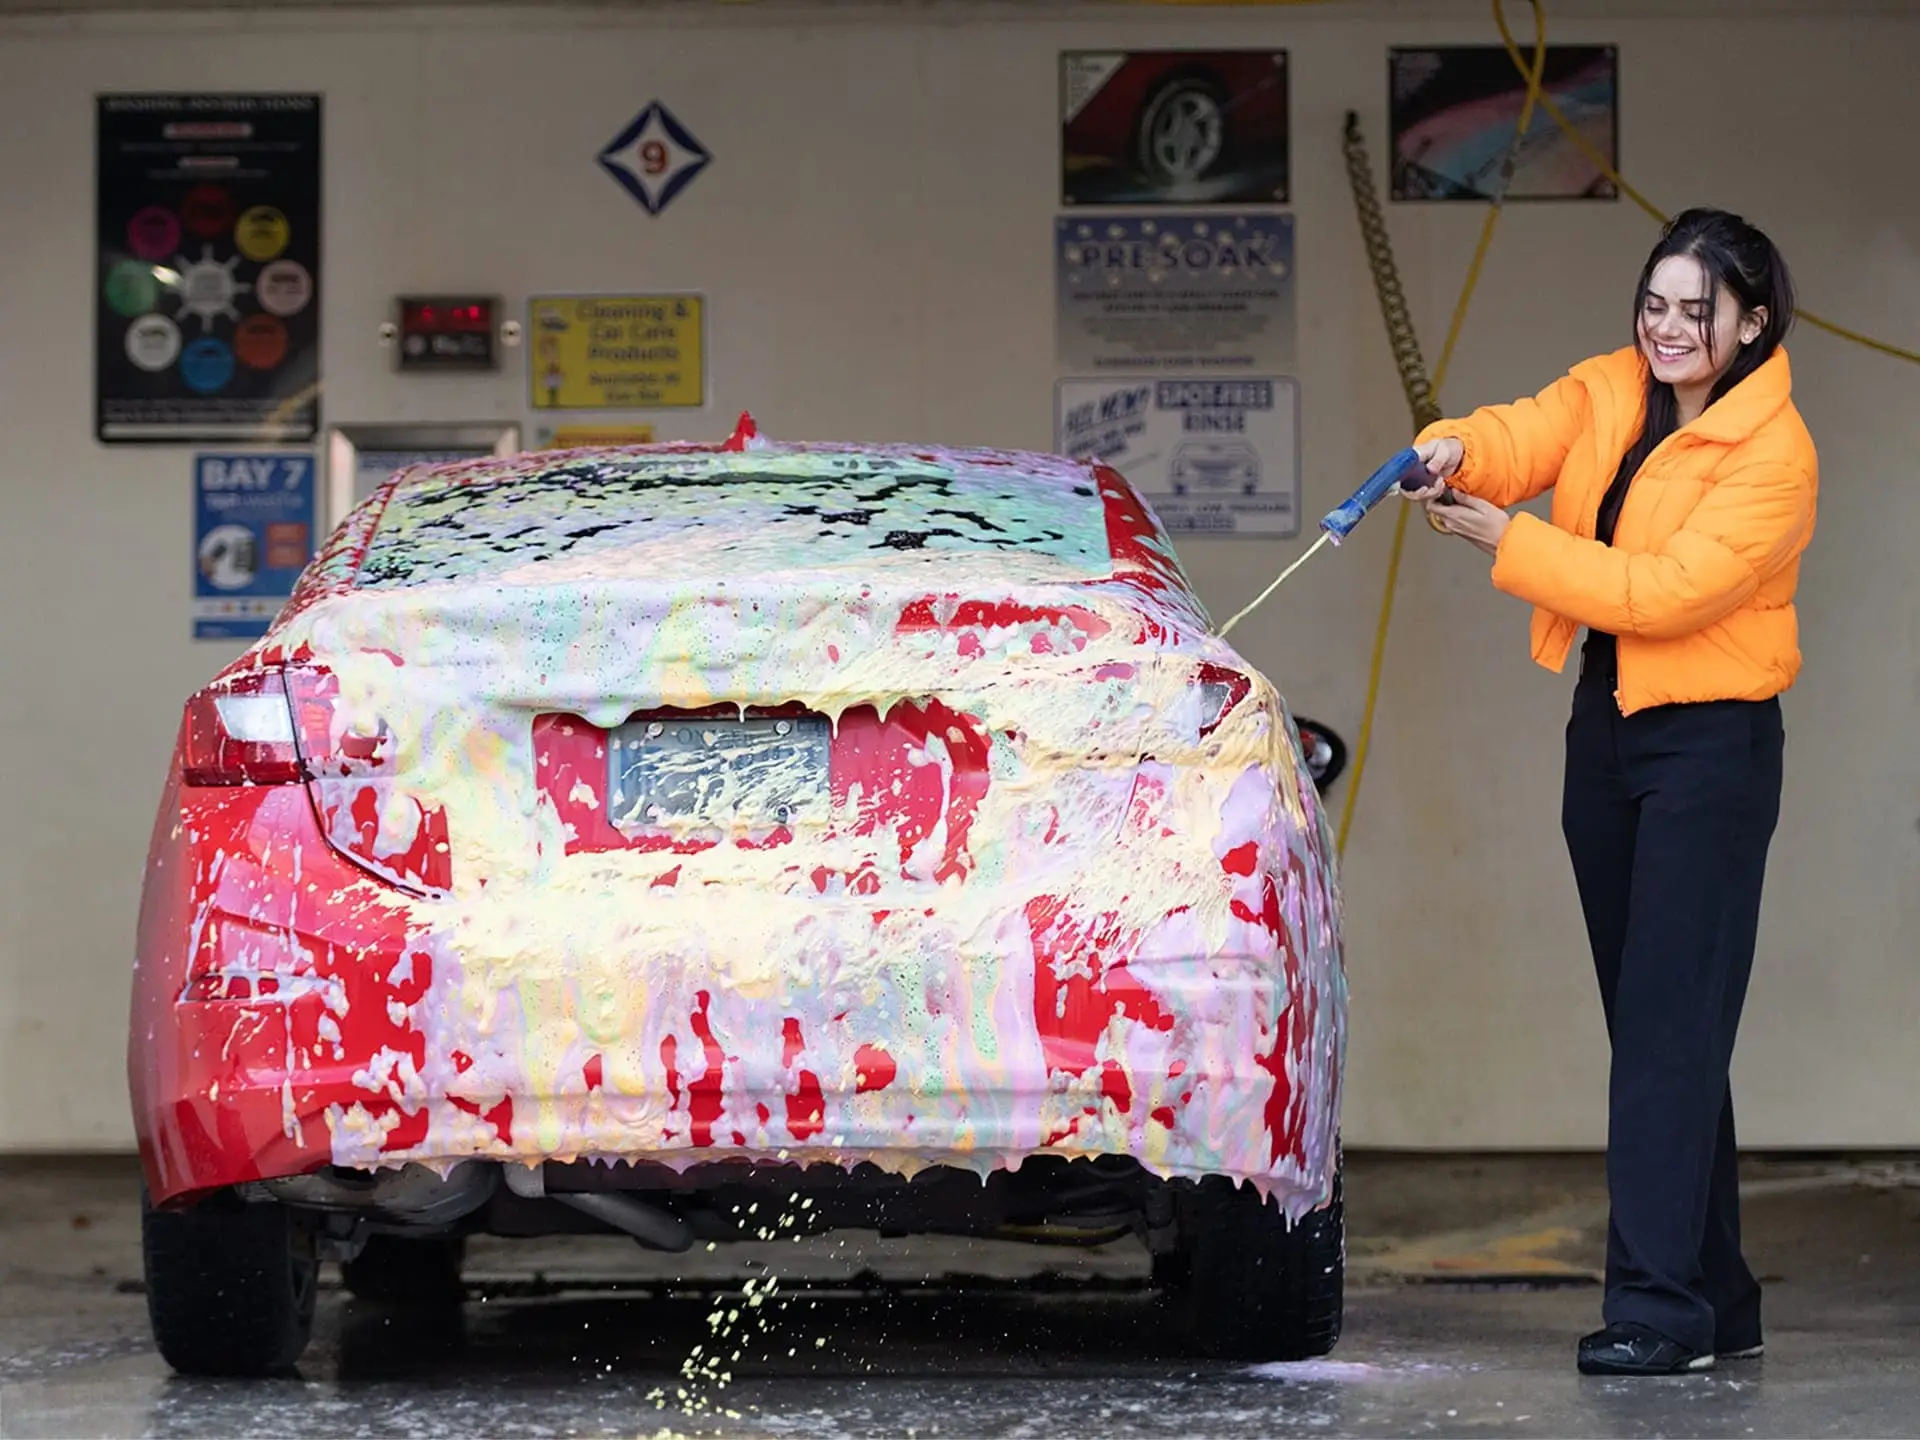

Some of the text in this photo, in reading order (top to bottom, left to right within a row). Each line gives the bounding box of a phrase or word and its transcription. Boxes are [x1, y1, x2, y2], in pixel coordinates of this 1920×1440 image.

[641, 140, 667, 174] 9
[577, 301, 666, 321] Cleaning
[589, 323, 676, 339] Car Care
[588, 343, 680, 361] Products
[1185, 411, 1245, 432] RINSE
[202, 458, 307, 490] BAY 7
